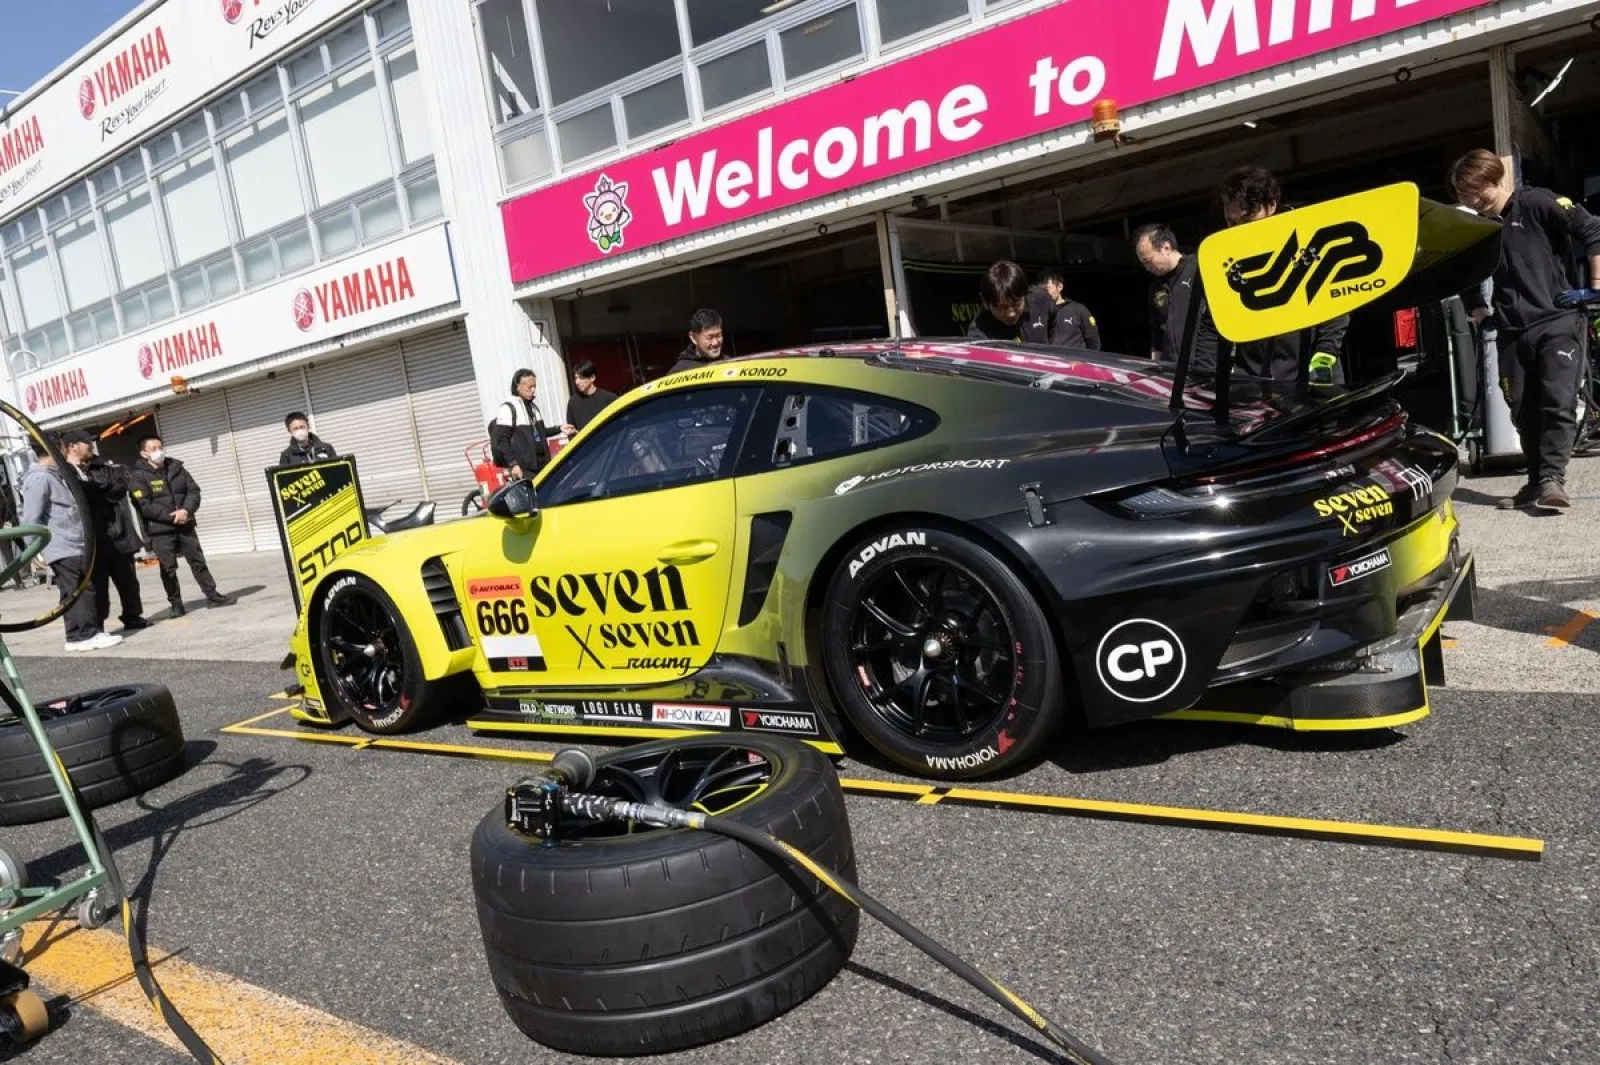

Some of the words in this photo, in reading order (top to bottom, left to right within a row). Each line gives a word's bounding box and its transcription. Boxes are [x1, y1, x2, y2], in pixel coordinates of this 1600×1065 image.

[94, 25, 171, 107] YAMAHA
[0, 113, 45, 176] AMAHA
[652, 83, 988, 226] Welcome
[1029, 55, 1106, 116] to
[314, 256, 415, 322] YAMAHA
[1330, 278, 1386, 299] BINGO
[534, 321, 544, 343] 7
[151, 321, 223, 373] YAMAHA
[35, 367, 89, 410] YAMAHA
[657, 370, 715, 389] FUJINAMI
[739, 367, 788, 377] KONDO
[280, 469, 321, 500] seven
[865, 459, 1012, 483] MOTORSPORT
[1313, 485, 1391, 517] seven
[1355, 501, 1394, 523] seven
[848, 531, 927, 579] ADVAN
[1347, 552, 1389, 576] YOKOHAMA
[478, 582, 521, 594] AUTOBACS
[530, 564, 693, 618] seven
[476, 598, 530, 636] 666
[600, 619, 702, 649] seven
[626, 656, 693, 676] racing
[1106, 640, 1174, 683] CP
[519, 703, 537, 714] COLD
[543, 704, 577, 715] NETWORK
[582, 701, 609, 714] LOGI
[613, 702, 643, 717] FLAG
[656, 708, 693, 722] NIHON
[694, 711, 727, 724] KIZAI
[758, 713, 813, 730] YOKOHAMA
[925, 747, 1000, 770] YOKOHAMA
